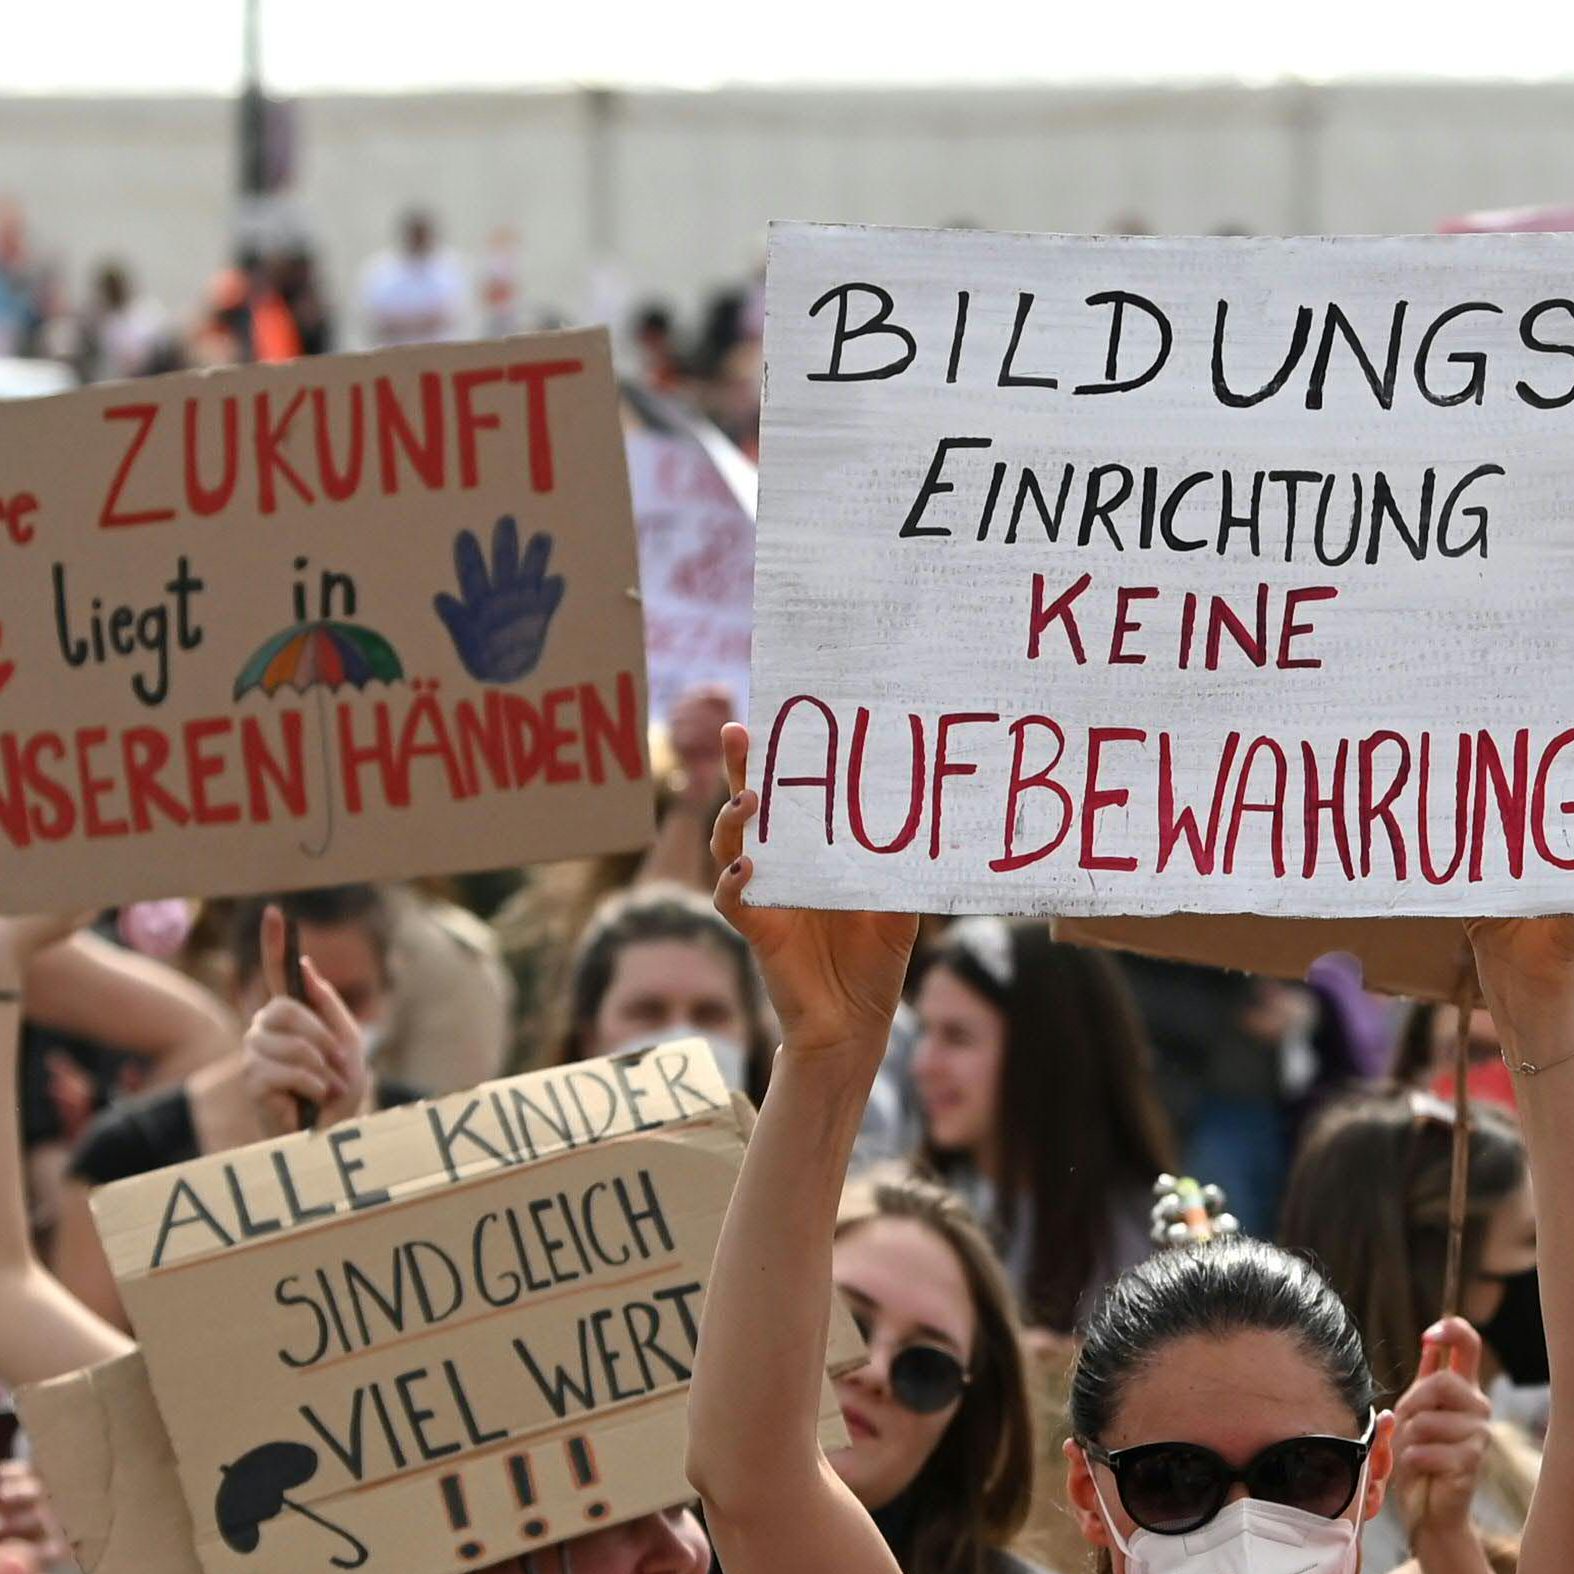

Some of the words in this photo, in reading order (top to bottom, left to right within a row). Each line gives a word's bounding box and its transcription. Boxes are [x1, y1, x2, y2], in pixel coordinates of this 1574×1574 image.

[97, 358, 583, 530] ZUKUNFT
[899, 437, 1508, 567] EINRICHTUNG
[51, 554, 204, 708] liegt
[293, 556, 358, 624] in
[1027, 572, 1339, 672] KEINE
[336, 671, 646, 815] HÄNDEN
[150, 1128, 391, 1269] ALLE
[427, 1050, 720, 1184] KINDER
[274, 1238, 466, 1370] SIND
[471, 1168, 676, 1309] GLEICH
[298, 1358, 509, 1482] VIEL
[511, 1280, 703, 1419] WERT
